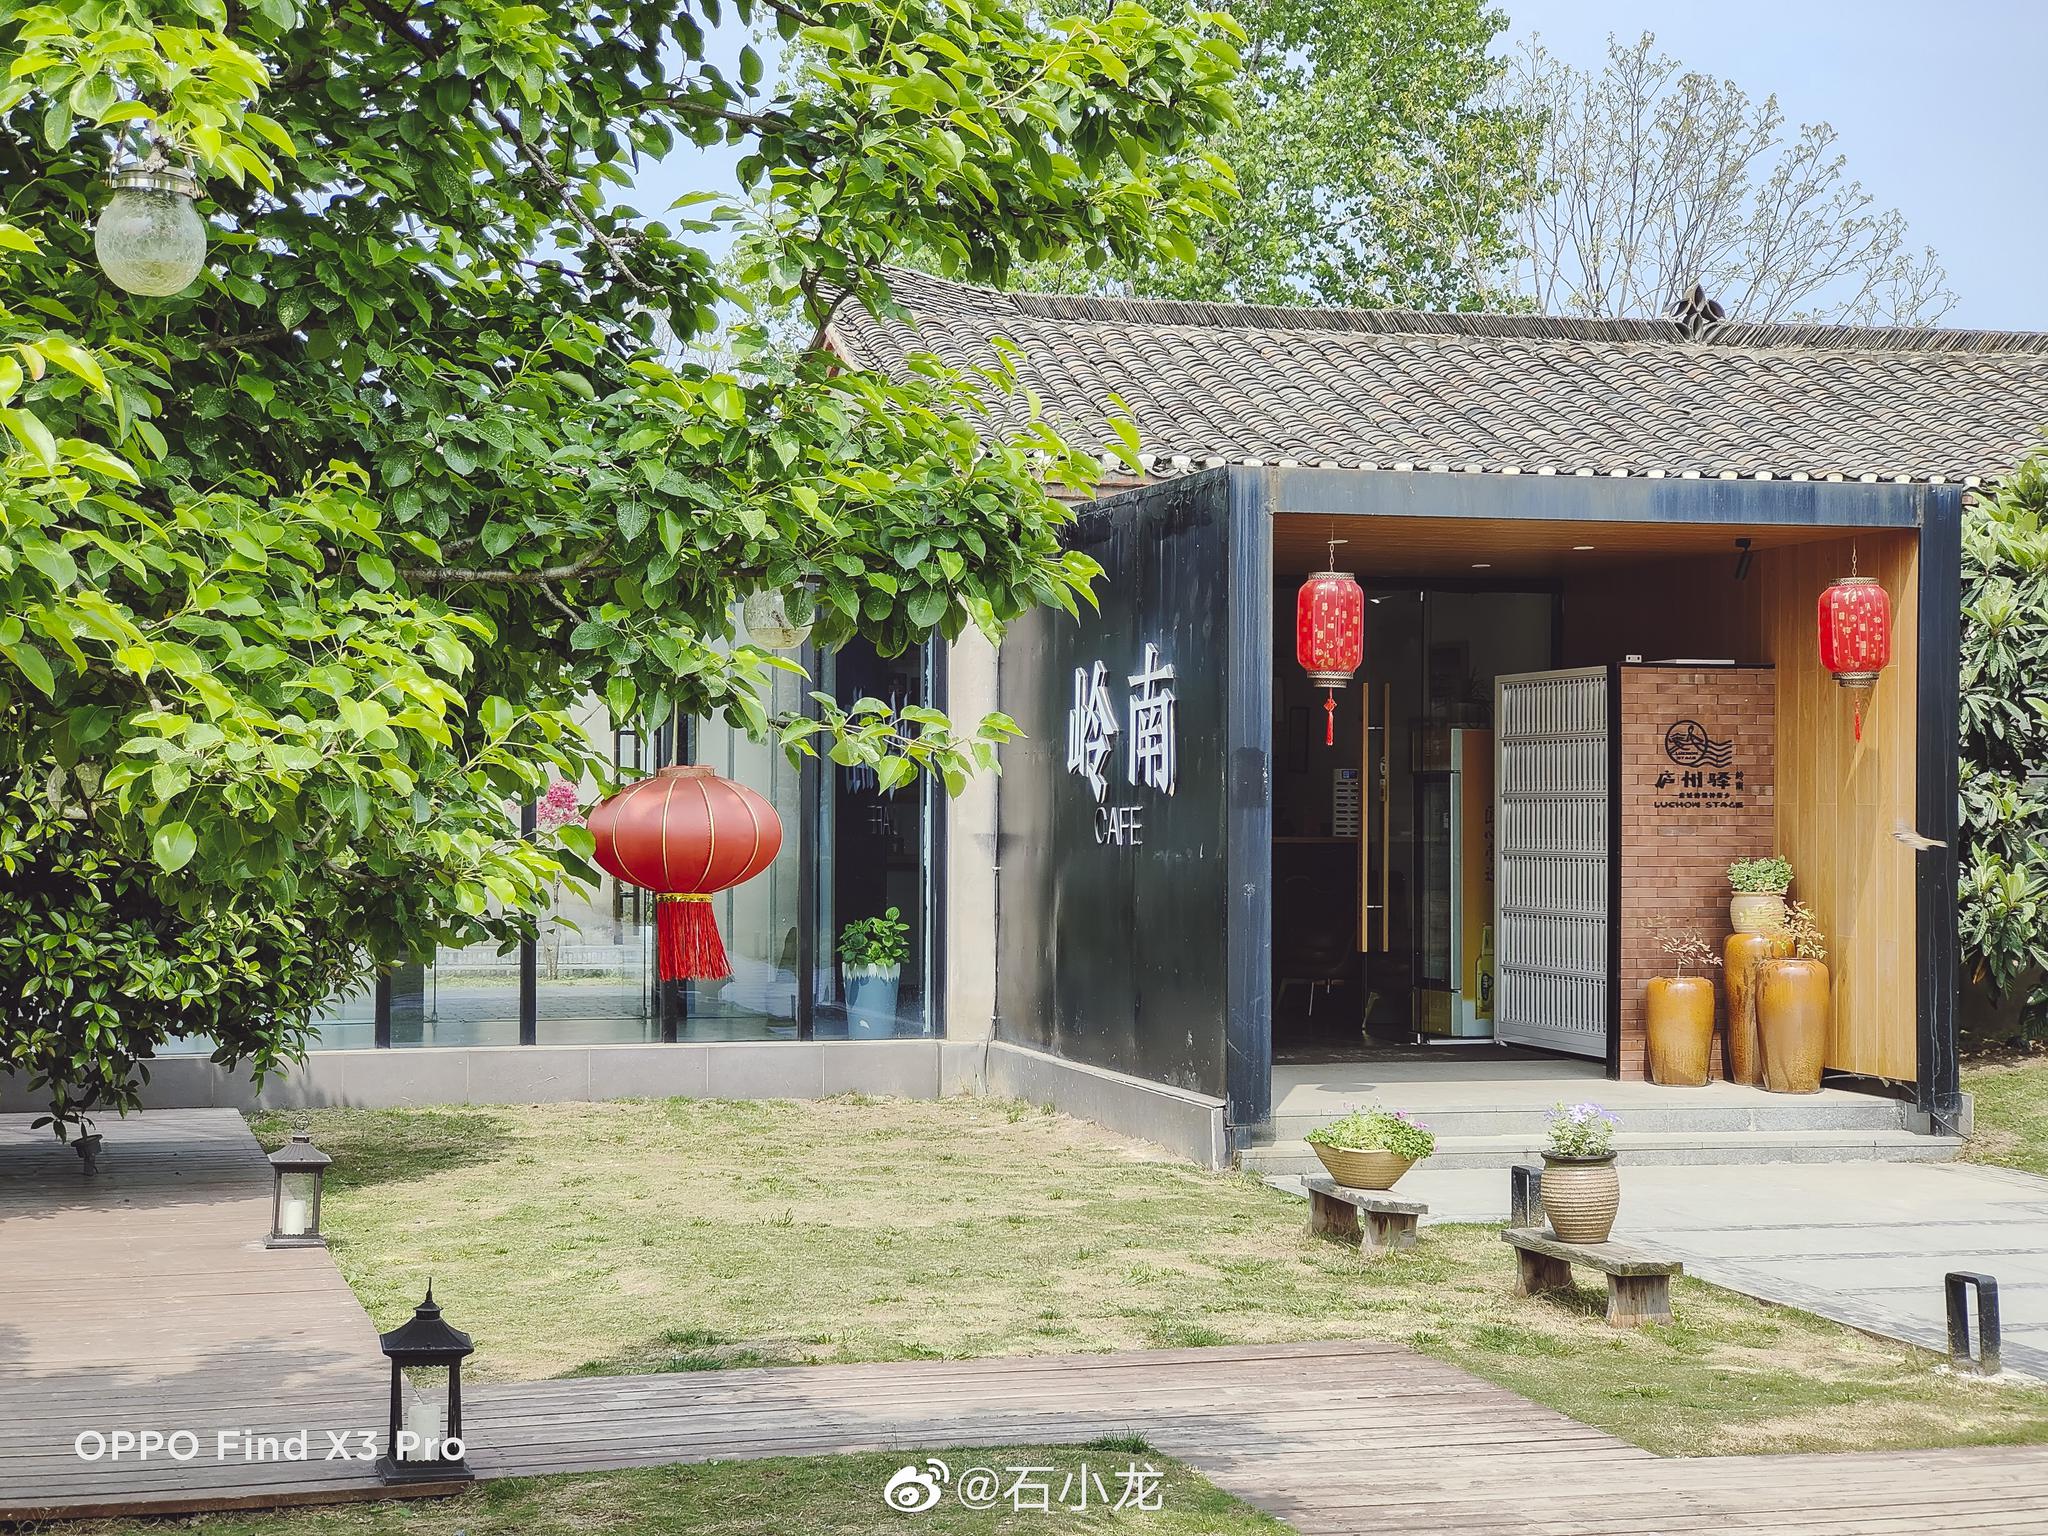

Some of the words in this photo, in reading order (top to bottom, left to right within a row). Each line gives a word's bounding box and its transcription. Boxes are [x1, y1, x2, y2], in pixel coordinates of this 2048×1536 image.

[1067, 642, 1177, 804] 岭南
[1654, 770, 1731, 790] 庐州驿
[1654, 801, 1701, 809] LUCHOW
[1705, 801, 1744, 809] STAGE
[1094, 806, 1144, 846] CAFE
